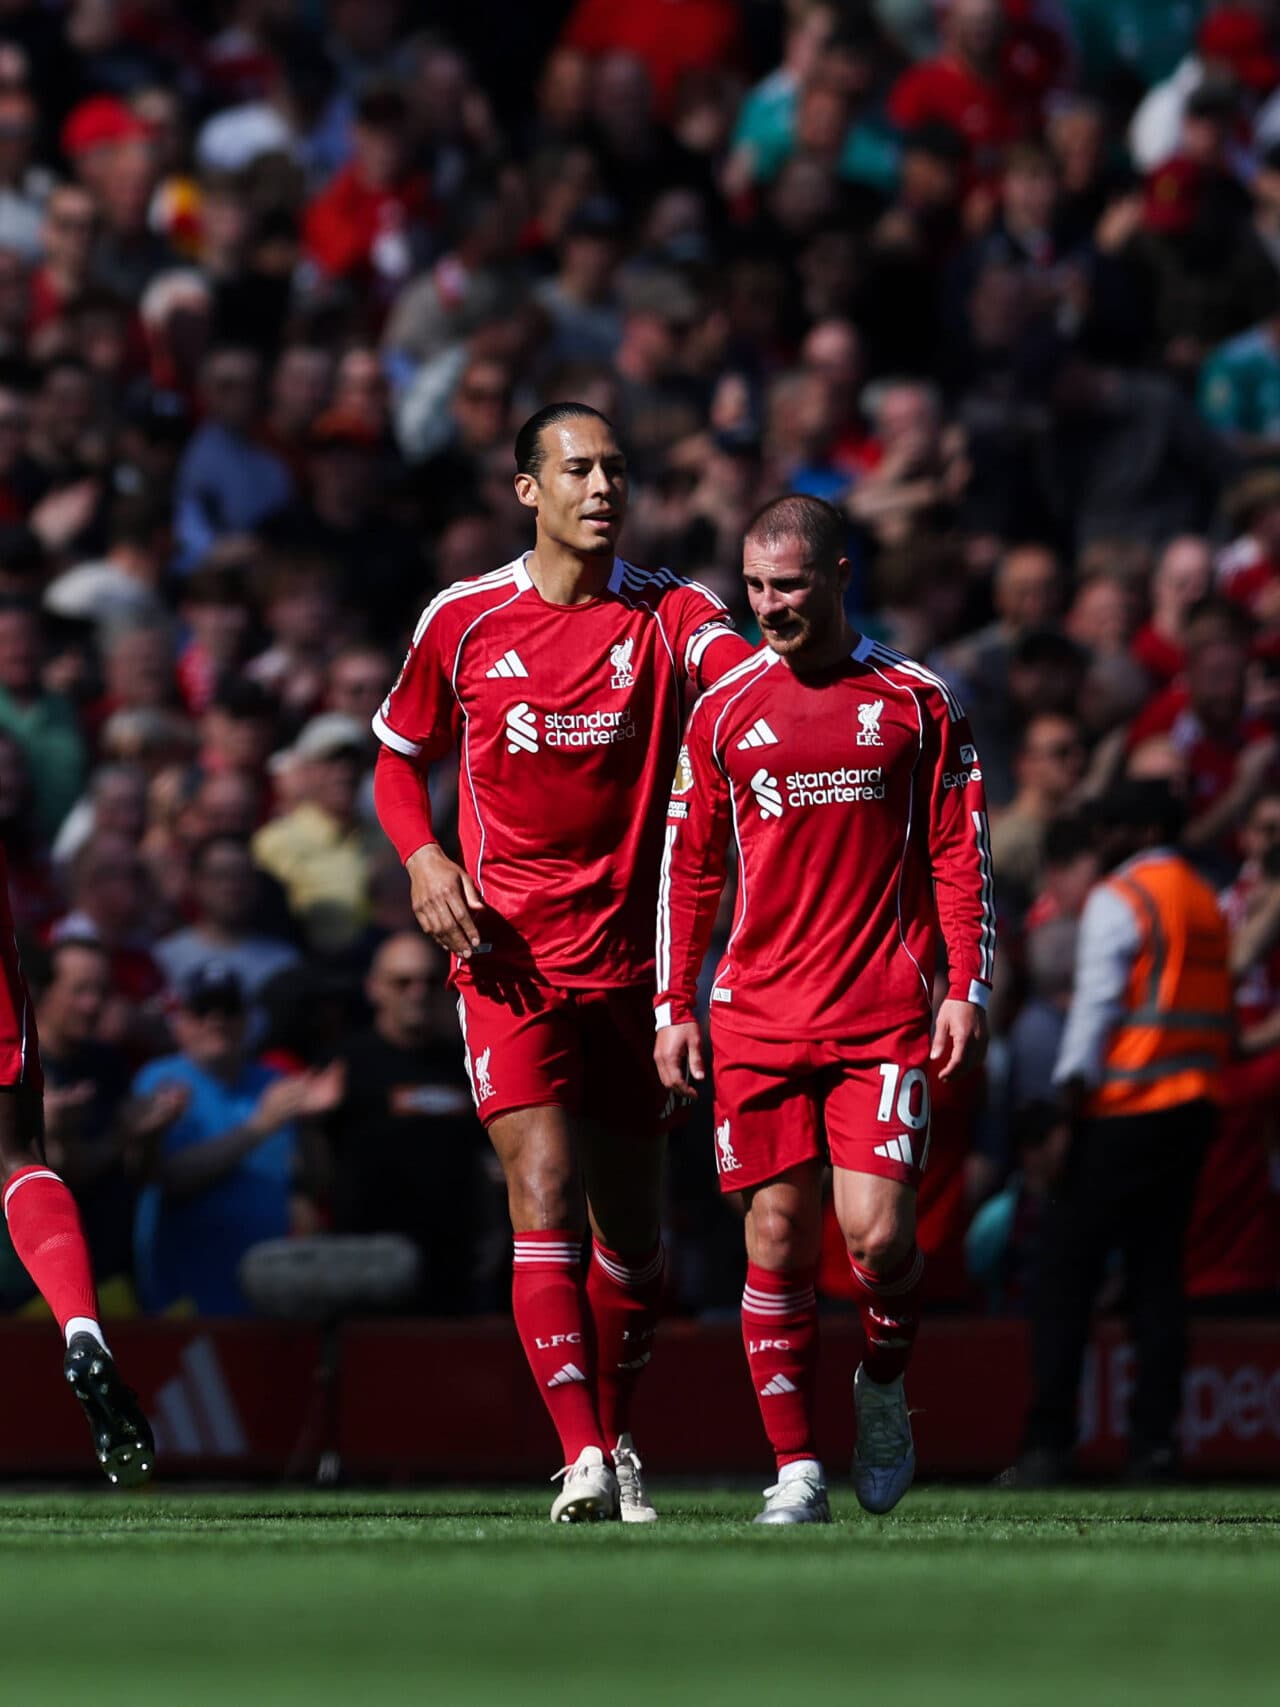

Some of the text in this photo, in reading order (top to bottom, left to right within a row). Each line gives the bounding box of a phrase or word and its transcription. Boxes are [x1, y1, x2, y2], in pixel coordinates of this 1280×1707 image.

[544, 706, 631, 729] standard
[545, 723, 637, 746] chartered
[785, 766, 882, 790] standard
[942, 768, 982, 789] Expe
[788, 783, 885, 808] chartered
[877, 1063, 929, 1129] 10
[535, 1332, 582, 1350] LFC
[749, 1339, 791, 1355] LFC
